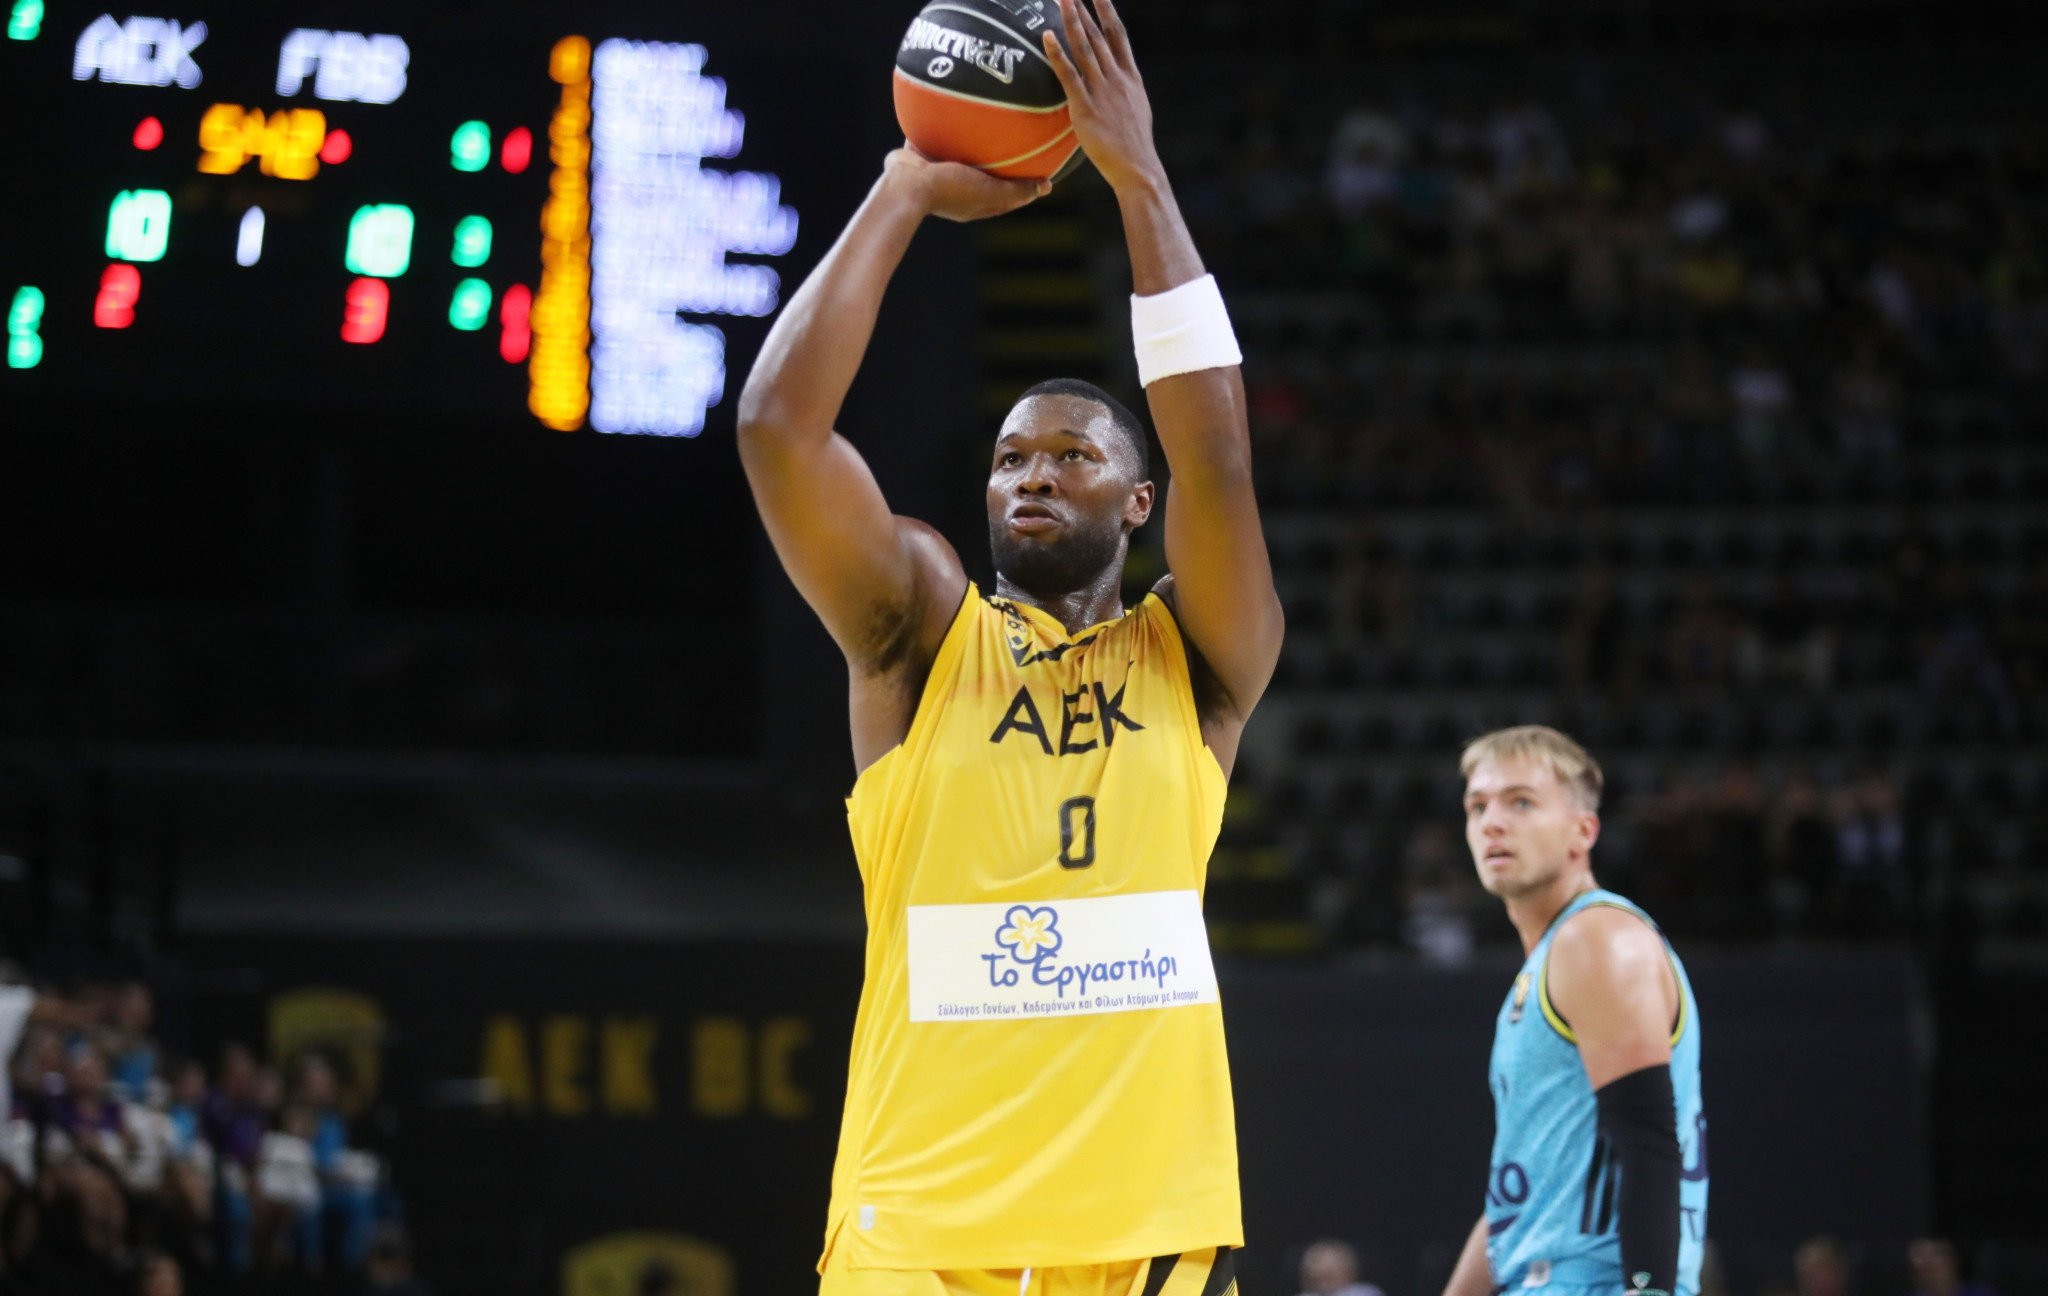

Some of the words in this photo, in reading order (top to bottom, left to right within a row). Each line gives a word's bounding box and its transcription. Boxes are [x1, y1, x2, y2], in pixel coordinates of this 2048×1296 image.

[73, 14, 207, 89] AEK
[989, 660, 1146, 757] AEK
[1058, 795, 1096, 870] 0
[1032, 948, 1177, 998] Εργαστήρι
[481, 1015, 660, 1115] AEK
